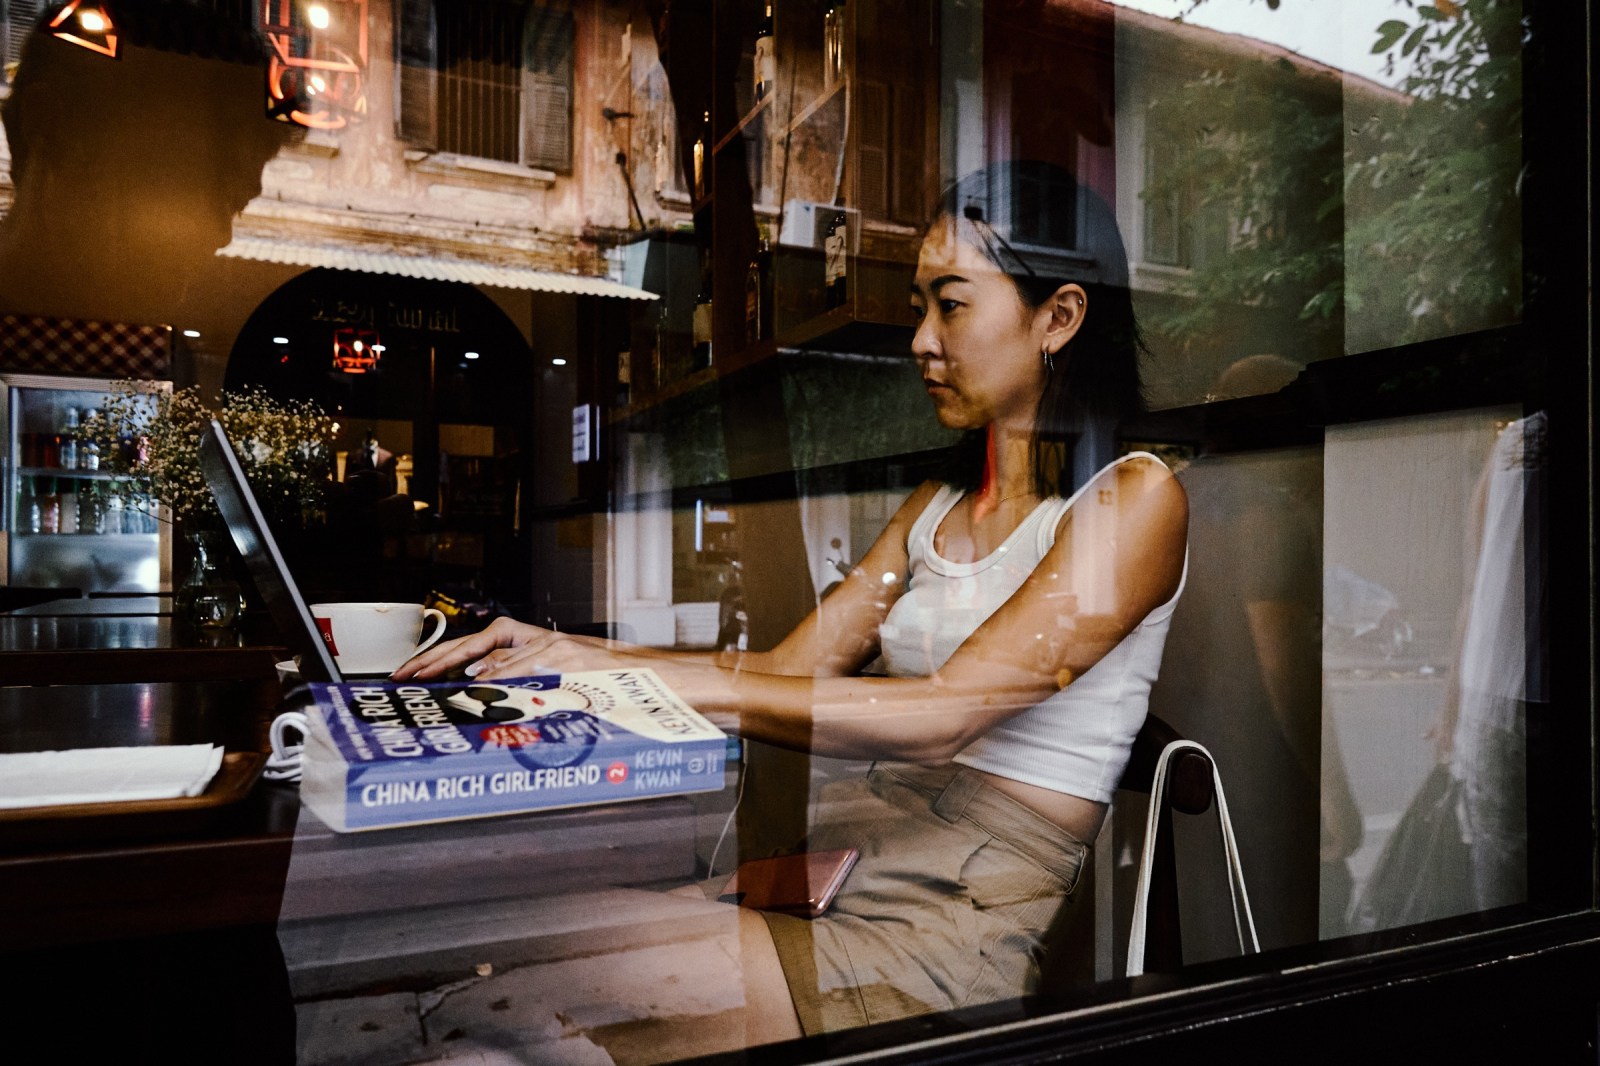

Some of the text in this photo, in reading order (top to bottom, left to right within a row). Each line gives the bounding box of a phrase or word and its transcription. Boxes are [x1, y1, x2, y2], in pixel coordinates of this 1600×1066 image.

[350, 686, 398, 717] RICH
[608, 672, 659, 704] KWAN
[396, 686, 473, 754] GIRLFRIEND
[641, 707, 697, 735] KEVIN
[369, 719, 424, 758] CHINA
[635, 748, 683, 769] KEVIN
[361, 764, 601, 807] CHINA RICH GIRLFRIEND
[635, 768, 681, 790] KWAN
